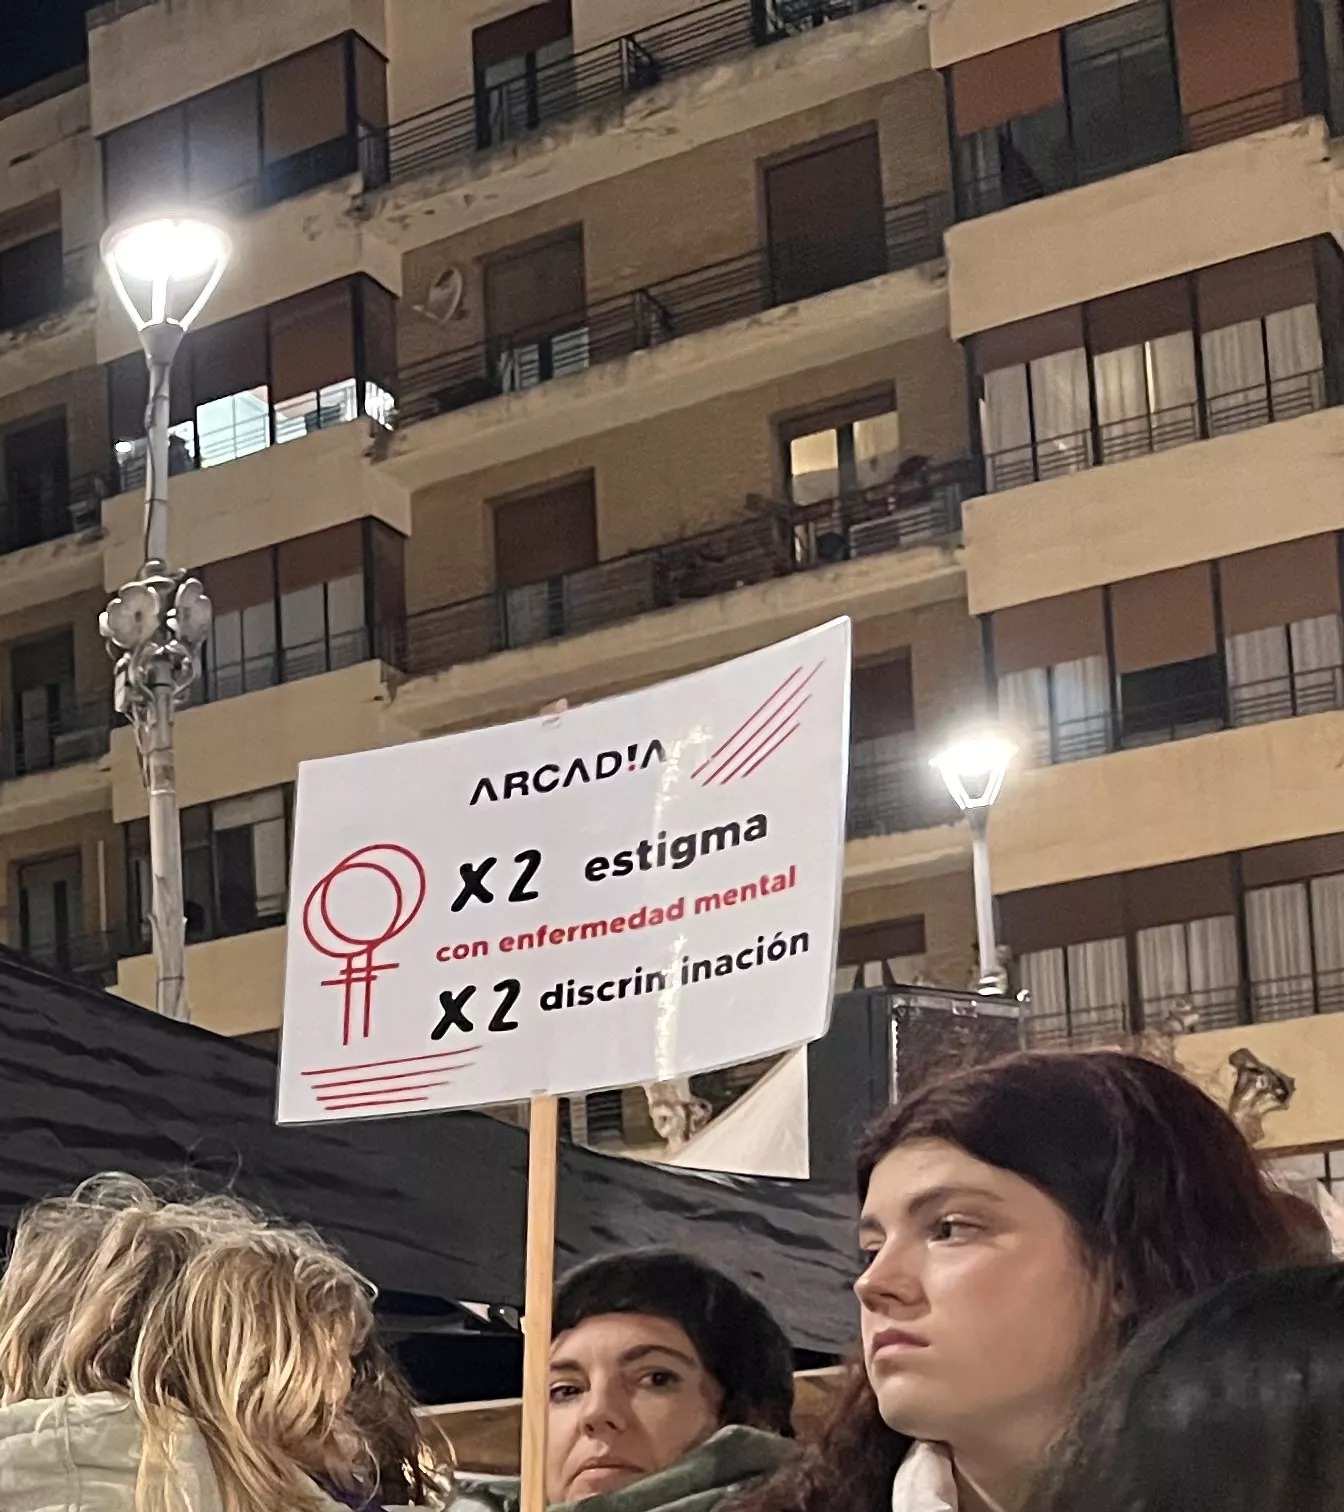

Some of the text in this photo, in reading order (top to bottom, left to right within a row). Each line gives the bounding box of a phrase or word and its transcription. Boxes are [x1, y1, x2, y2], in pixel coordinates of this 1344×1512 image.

[584, 814, 768, 882] estigma
[436, 866, 796, 964] con enfermedad mental
